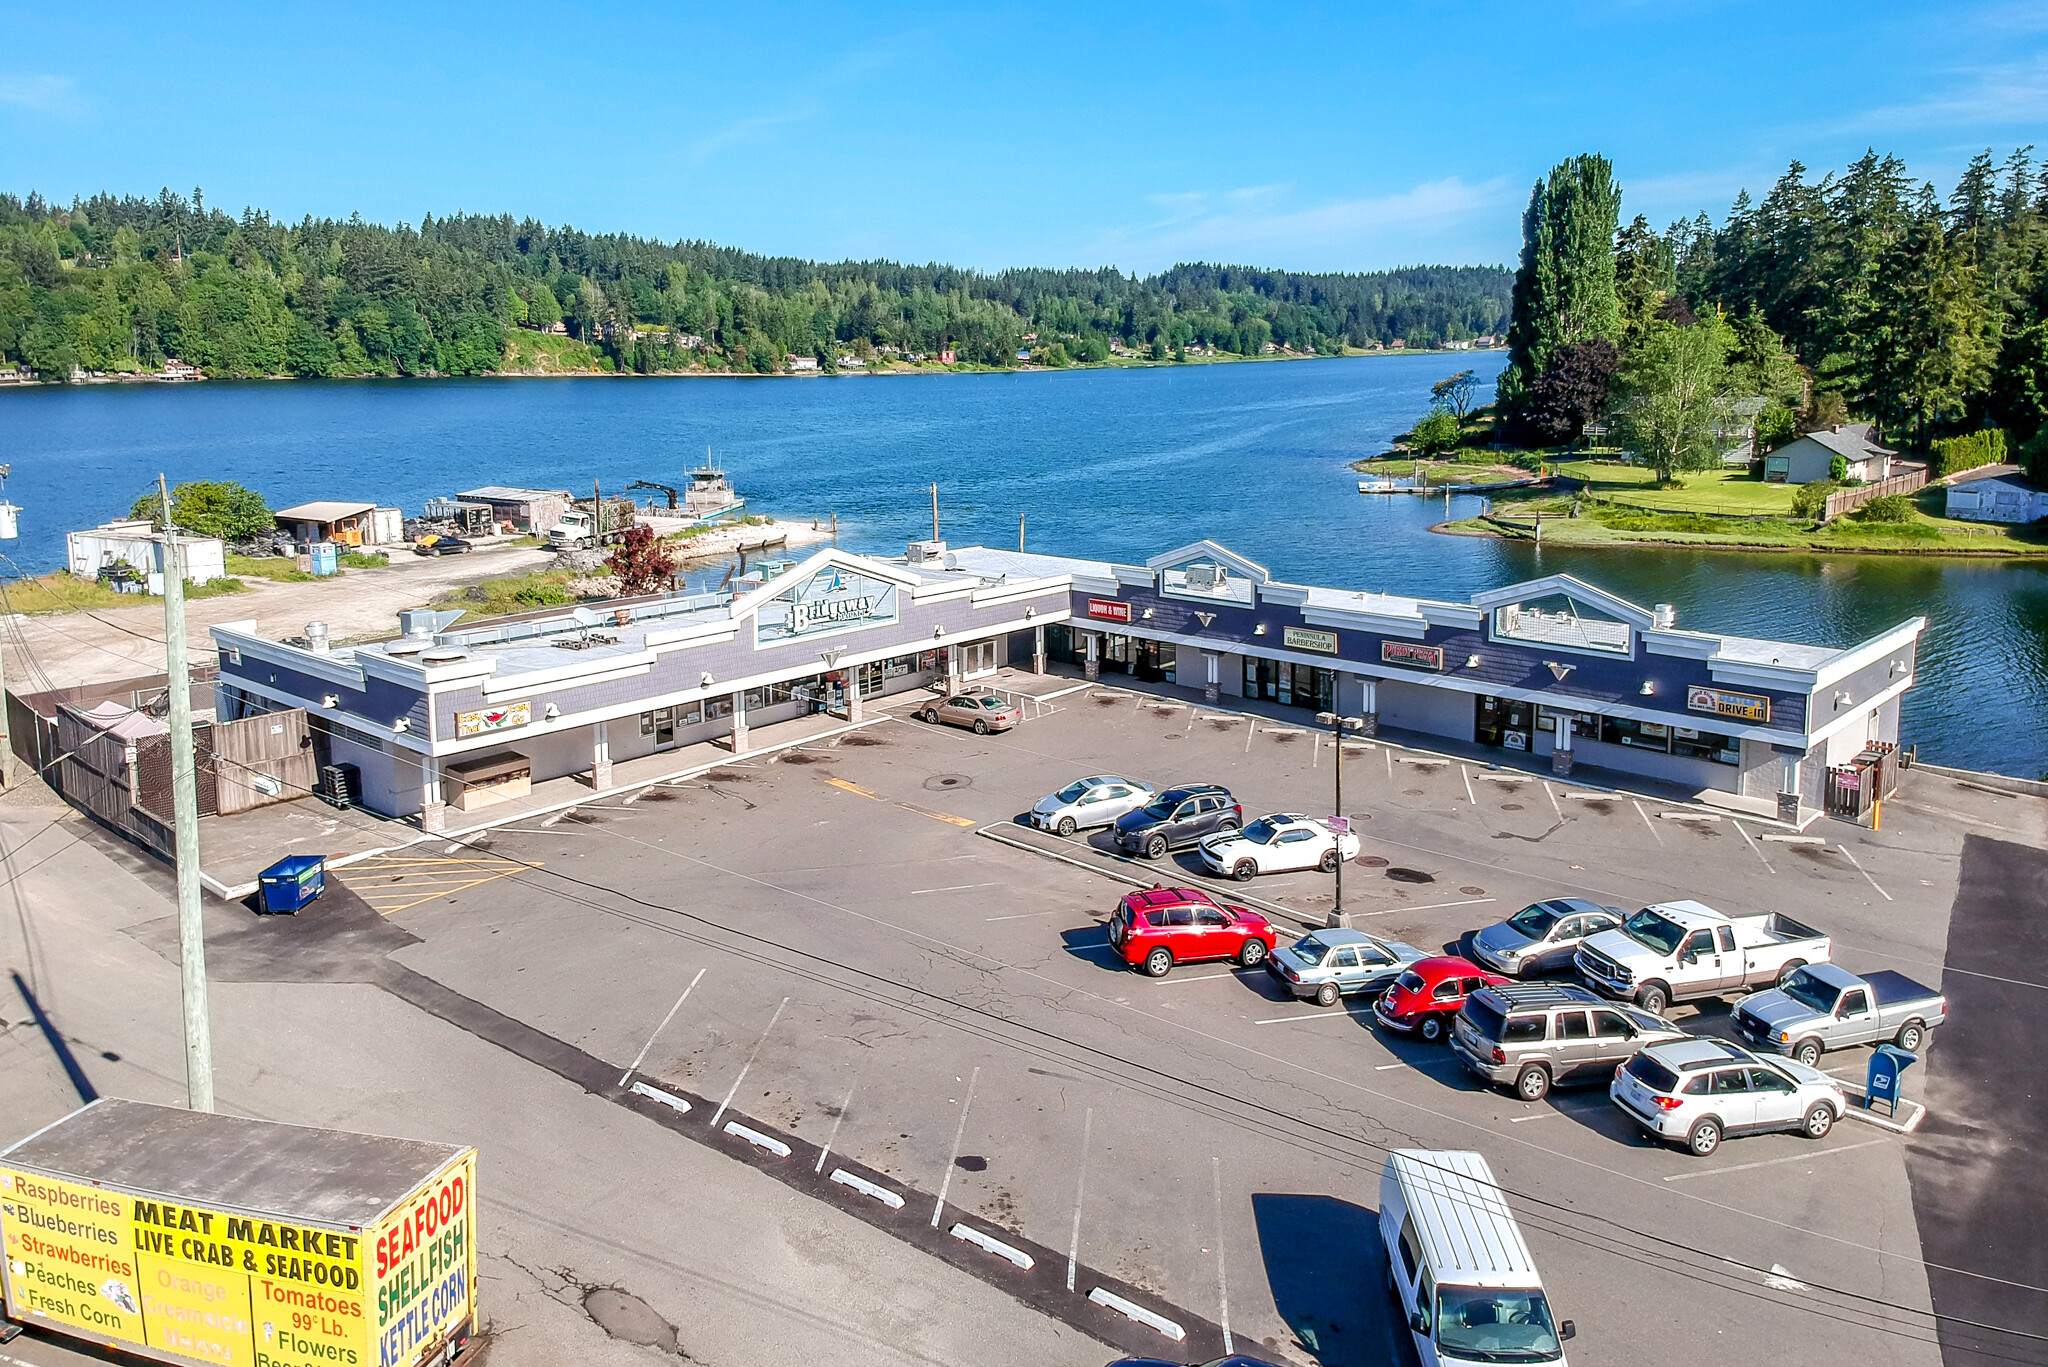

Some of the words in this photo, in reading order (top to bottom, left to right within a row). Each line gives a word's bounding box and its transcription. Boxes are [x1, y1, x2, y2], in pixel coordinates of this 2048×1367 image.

[793, 595, 876, 632] Bridgeway
[1090, 603, 1107, 614] LIQUOR
[1108, 605, 1113, 615] &
[1113, 606, 1127, 617] WINE
[1287, 637, 1332, 650] BARBERSHOP
[1292, 631, 1326, 641] PENINSULA
[459, 713, 482, 723] Easy
[509, 703, 531, 714] Easy
[512, 714, 525, 724] Go
[1718, 702, 1764, 718] DRIVE-IN
[459, 723, 480, 735] Thai
[15, 1175, 121, 1217] Raspberries
[17, 1205, 118, 1245] Blueberries
[134, 1200, 213, 1235] MEAT
[227, 1218, 358, 1260] MARKET
[376, 1176, 463, 1279] SEAFOOD
[21, 1233, 132, 1277] Strawberries
[135, 1228, 174, 1256] LIVE
[182, 1238, 234, 1267] CRAB
[243, 1249, 258, 1272] &
[266, 1253, 359, 1290] SEAFOOD
[25, 1261, 97, 1296] Peaches
[157, 1269, 226, 1302] Orange
[378, 1219, 463, 1327] SHELLFISH
[29, 1289, 75, 1317] Fresh
[80, 1303, 121, 1329] Corn
[143, 1294, 249, 1335] Creamsicle
[261, 1280, 362, 1318] Tomatoes
[379, 1296, 429, 1367] KETTLE
[432, 1264, 465, 1326] CORN
[164, 1327, 232, 1360] Melons
[321, 1317, 348, 1338] Lb.
[278, 1330, 358, 1364] Flowers
